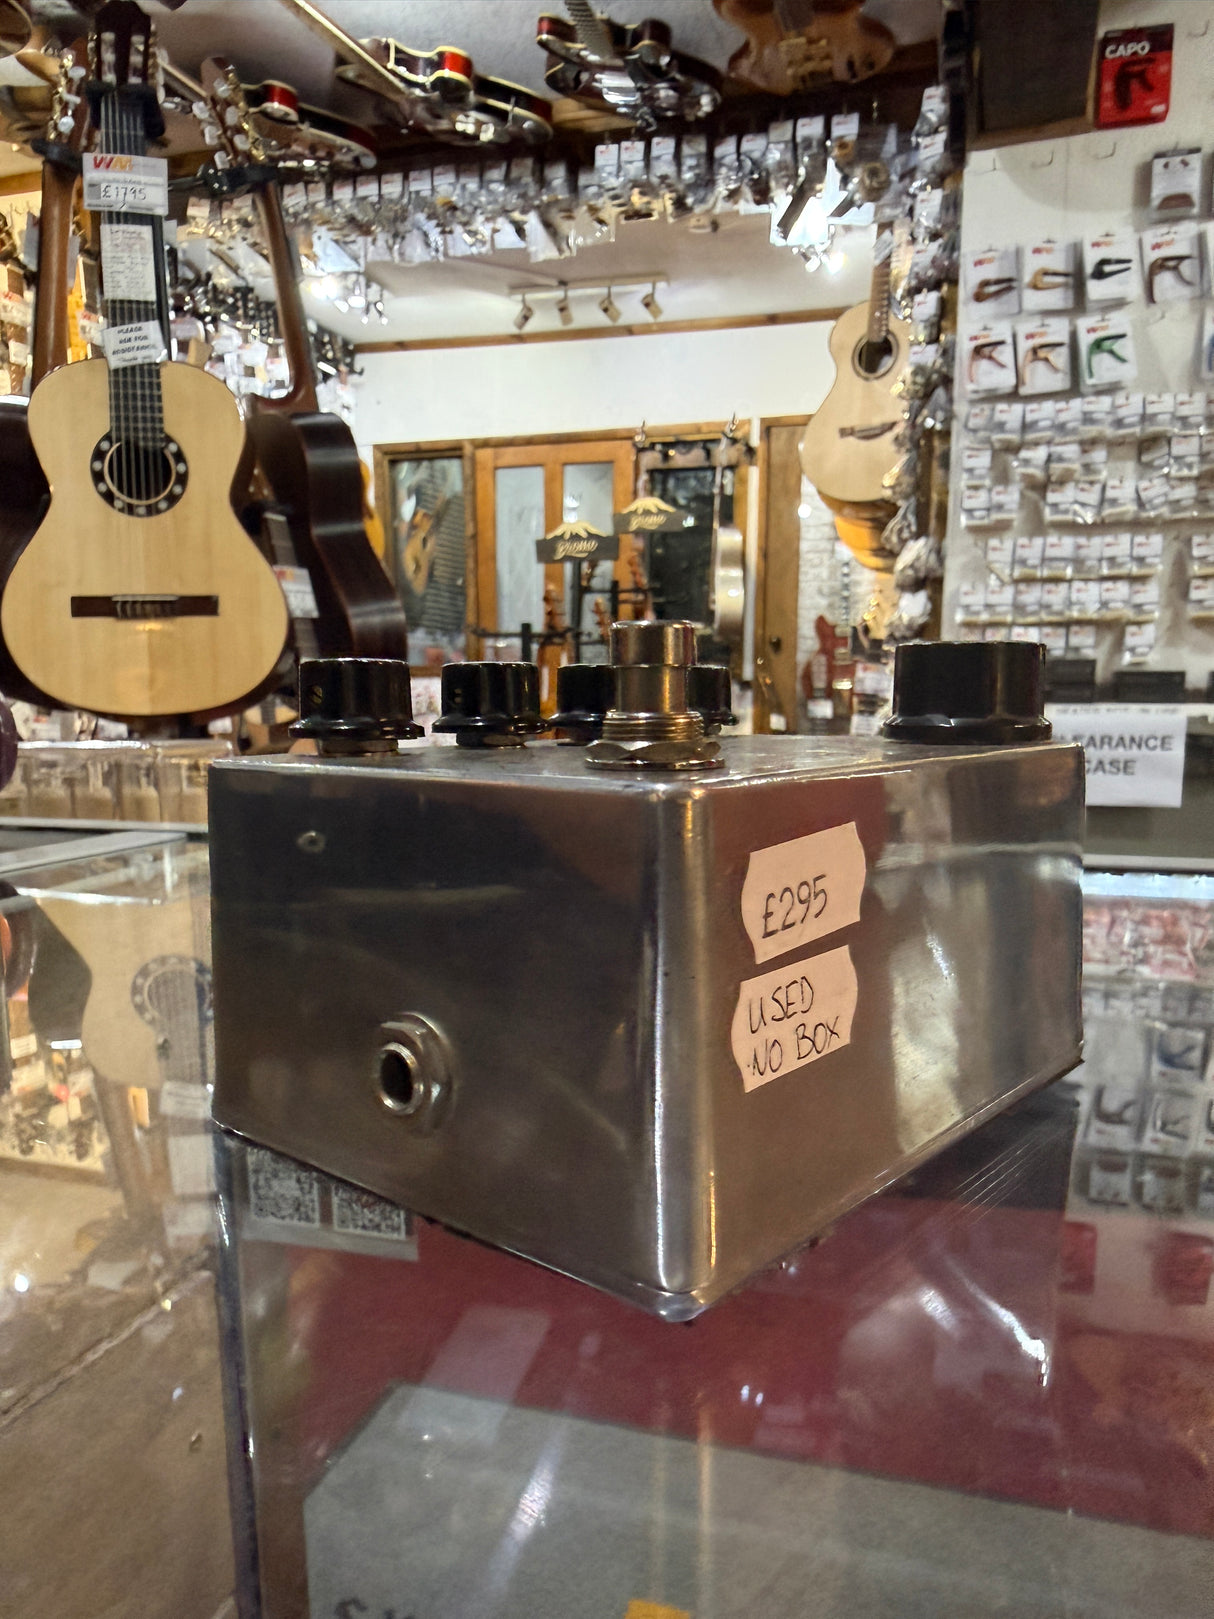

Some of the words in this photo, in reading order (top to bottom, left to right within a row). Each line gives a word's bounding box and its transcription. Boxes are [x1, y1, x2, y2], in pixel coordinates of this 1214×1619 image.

[1104, 40, 1151, 59] CAPO
[761, 873, 828, 939] £295
[748, 975, 814, 1034] USED
[749, 1038, 784, 1077] NO
[795, 1015, 841, 1061] BOX
